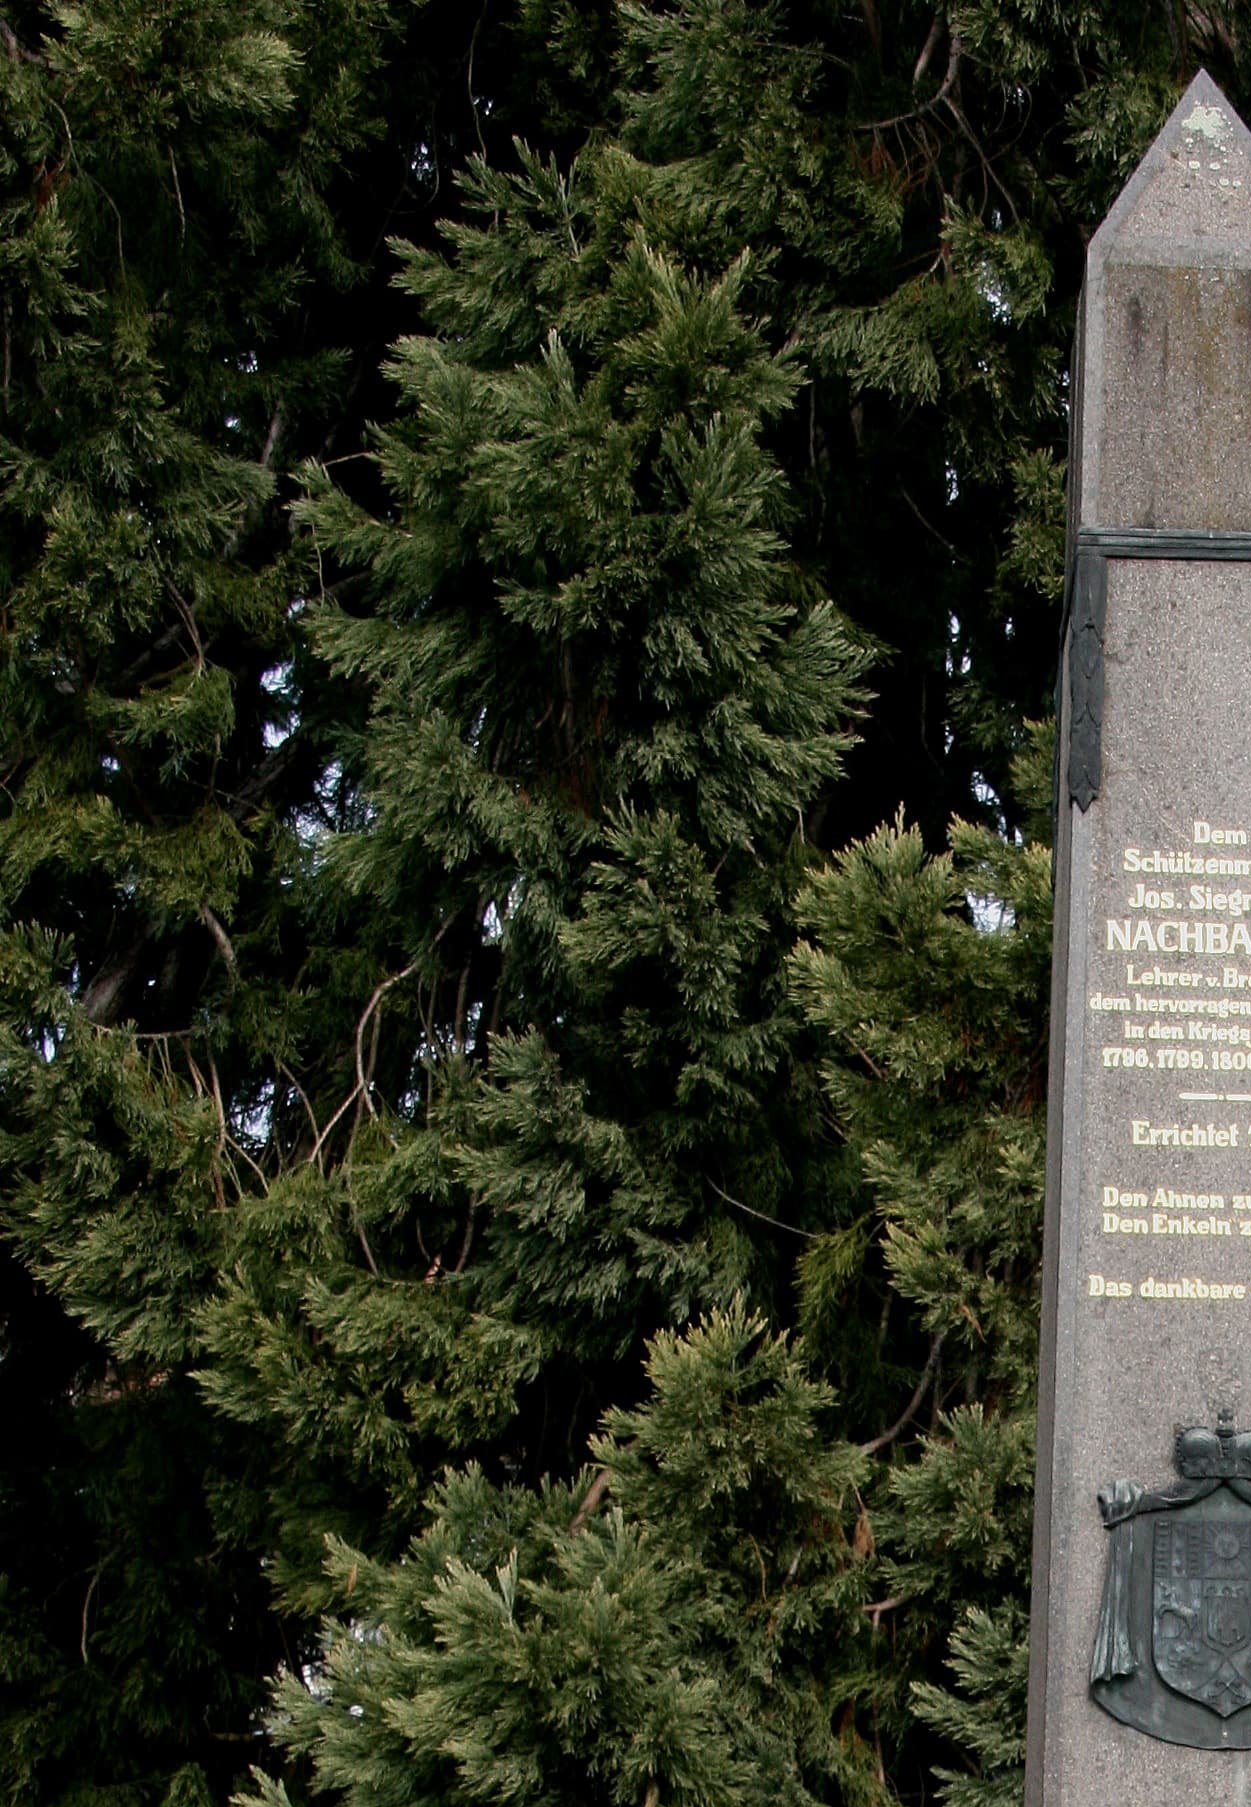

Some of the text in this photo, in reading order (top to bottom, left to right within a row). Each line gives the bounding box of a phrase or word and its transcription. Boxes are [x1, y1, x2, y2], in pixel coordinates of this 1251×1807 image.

[1193, 821, 1247, 845] Dem
[1128, 883, 1182, 909] Jos.
[1126, 964, 1203, 987] Lehrer
[1205, 975, 1221, 988] v.
[1089, 993, 1131, 1011] dem
[1124, 1020, 1144, 1038] in
[1148, 1021, 1184, 1040] den
[1132, 1120, 1238, 1147] Errichtet
[1102, 1187, 1148, 1207] Den
[1152, 1188, 1224, 1209] Ahnen
[1102, 1213, 1148, 1233] Den
[1152, 1214, 1232, 1235] Enkeln
[1088, 1274, 1132, 1297] Das
[1140, 1277, 1246, 1299] dankbare
